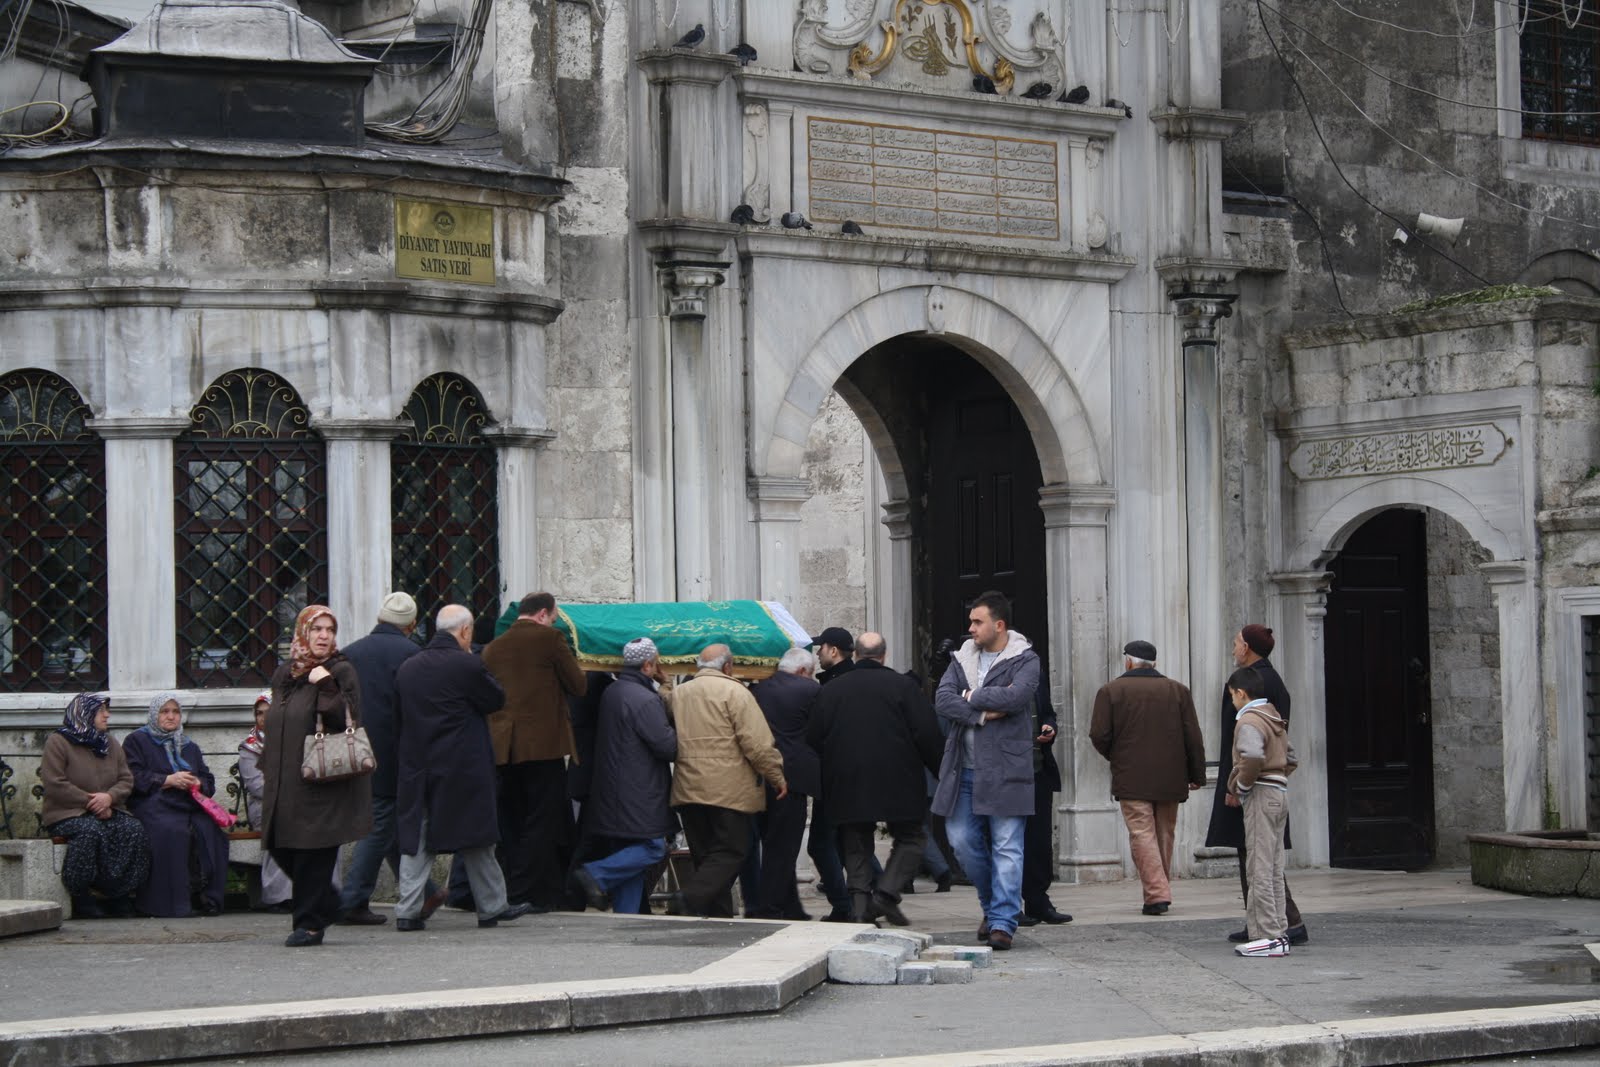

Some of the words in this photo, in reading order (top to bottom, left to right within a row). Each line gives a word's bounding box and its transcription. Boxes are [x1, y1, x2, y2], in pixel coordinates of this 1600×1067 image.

[399, 232, 440, 253] DİYANET
[442, 239, 492, 258] YAYINLARI
[420, 257, 447, 277] SATIŞ
[448, 258, 472, 276] YERİ
